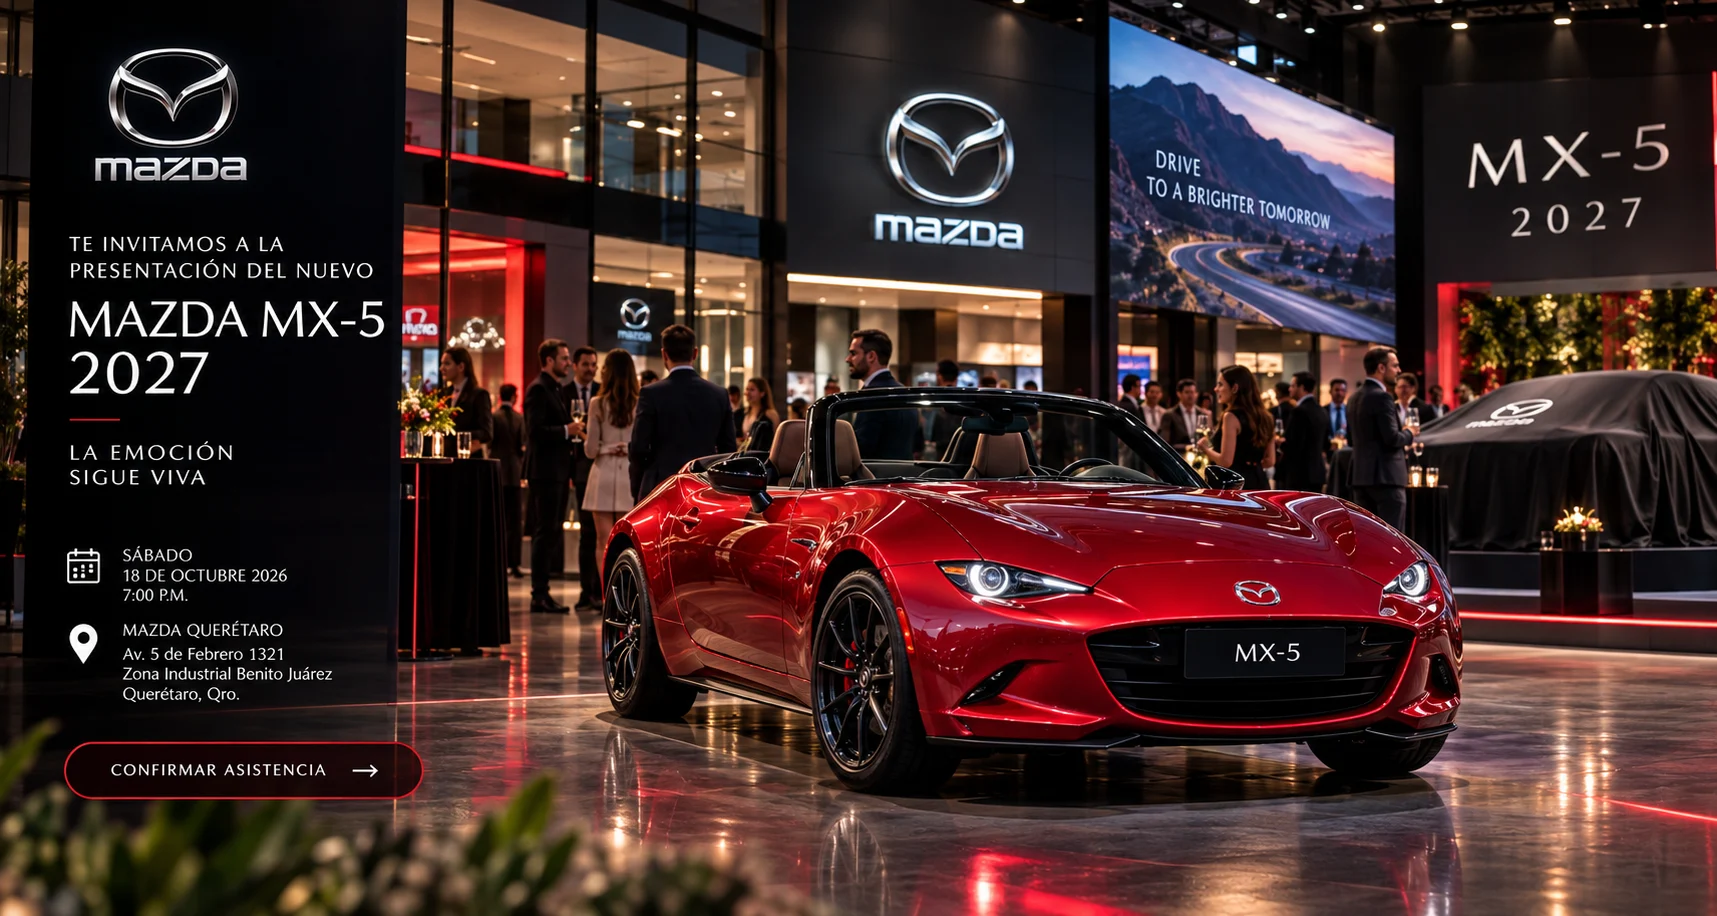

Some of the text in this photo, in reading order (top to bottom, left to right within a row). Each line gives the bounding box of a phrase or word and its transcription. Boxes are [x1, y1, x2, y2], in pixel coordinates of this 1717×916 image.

[1156, 150, 1201, 177] DRIVE
[1468, 123, 1669, 189] MX-5
[1146, 176, 1331, 230] TO A BRIGHTER TOMORROW
[1511, 197, 1642, 237] 2027
[1235, 642, 1301, 663] MX-5
